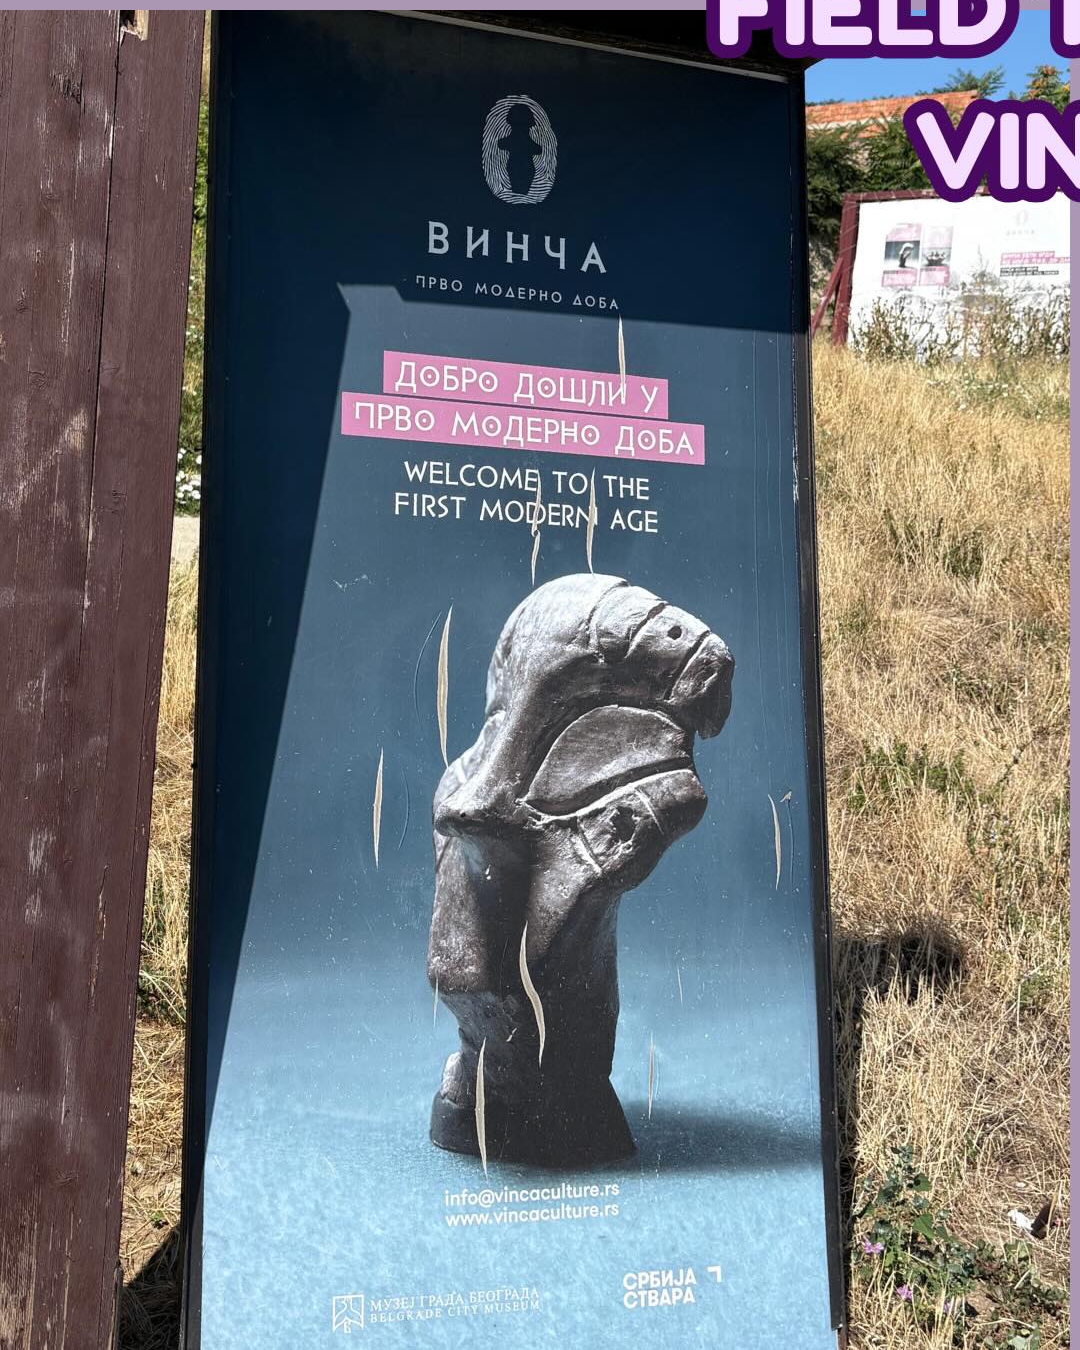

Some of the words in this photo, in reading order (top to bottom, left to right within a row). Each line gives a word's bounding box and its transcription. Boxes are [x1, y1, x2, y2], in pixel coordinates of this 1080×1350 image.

[427, 220, 607, 274] ВИНЧА
[415, 275, 463, 292] ПРВО
[474, 282, 562, 304] МОДЕРНО
[572, 294, 619, 311] ДОБА
[394, 360, 498, 394] ДОБРО
[513, 372, 627, 407] ДОШЛИ
[640, 384, 659, 414] У
[354, 401, 435, 432] ПРВО
[451, 411, 600, 447] МОДЕРНО
[614, 425, 695, 456] ДОБА
[404, 460, 539, 492] WELCOME
[552, 470, 588, 495] TO
[603, 475, 650, 501] THE
[394, 493, 466, 520] FIRST
[479, 498, 598, 528] MODERN
[610, 507, 659, 534] AGE
[444, 1182, 620, 1208] info@vincaculture.rs
[445, 1201, 620, 1227] www.vincaculture.rs
[622, 1267, 697, 1291] СРБИЈА
[370, 1296, 415, 1312] МУЗЕЈ
[420, 1293, 464, 1308] ГРАДА
[469, 1287, 540, 1303] БЕОГРАДА
[370, 1308, 441, 1324] BELGRADE
[448, 1305, 478, 1317] CITY
[484, 1300, 540, 1314] MUSEUM
[623, 1287, 696, 1310] СТВАРА
